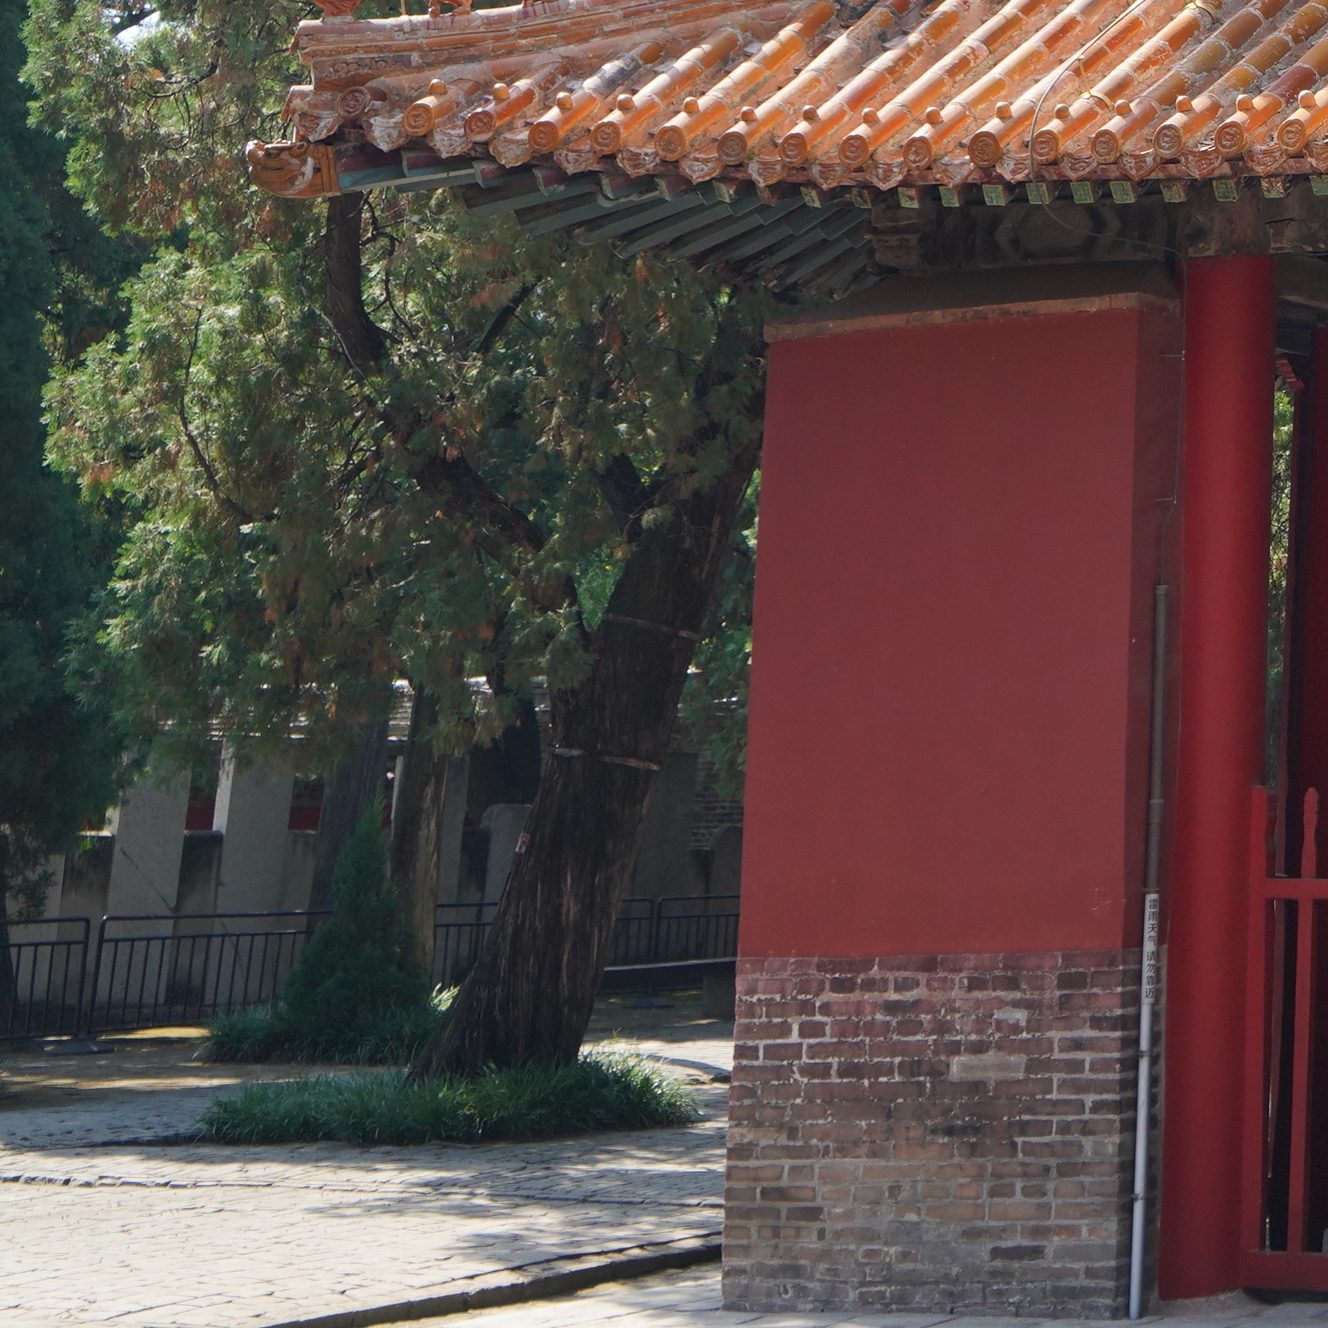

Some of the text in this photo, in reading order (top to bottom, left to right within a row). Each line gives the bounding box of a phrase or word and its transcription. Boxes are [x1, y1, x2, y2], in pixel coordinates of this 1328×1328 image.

[1144, 898, 1159, 998] 雷雨天气 请勿靠近
